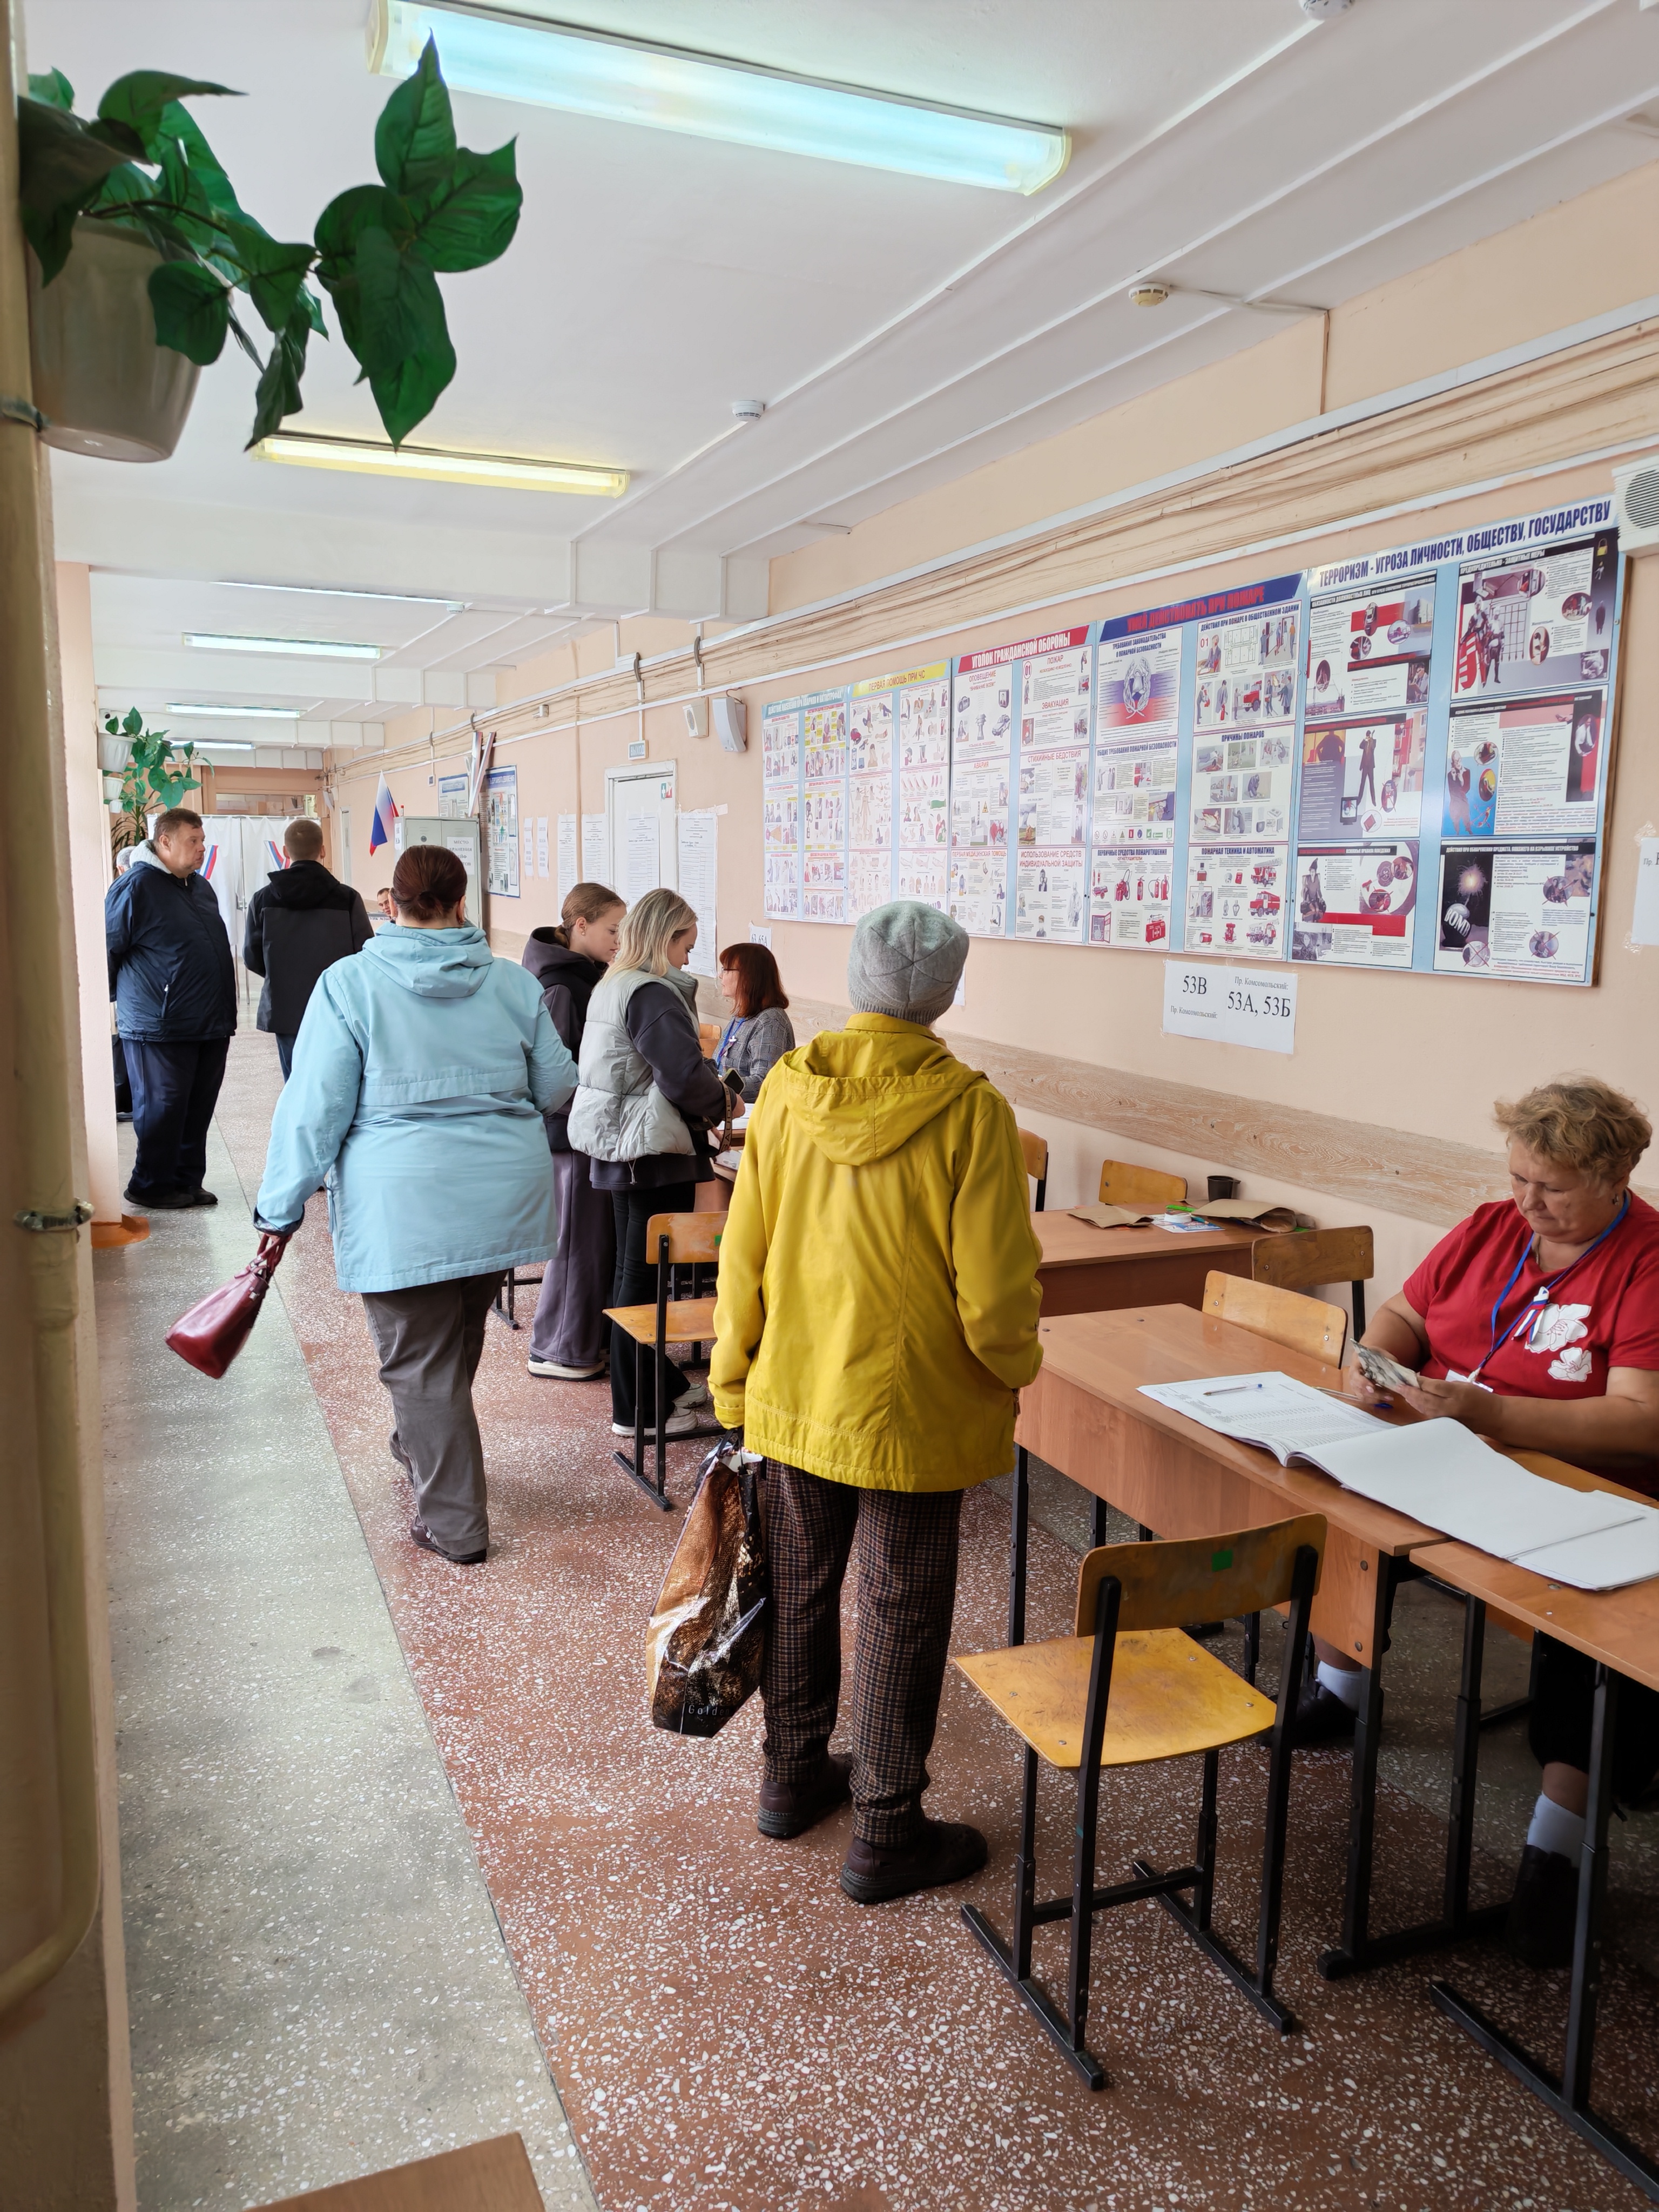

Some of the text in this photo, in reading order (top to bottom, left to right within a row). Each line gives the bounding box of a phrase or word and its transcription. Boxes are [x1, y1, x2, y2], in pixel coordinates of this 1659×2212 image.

[1320, 567, 1368, 587] ТЕРРОРИЗМ
[1375, 554, 1408, 574] УГРОЗА
[1410, 537, 1464, 565] ЛИЧНОСТИ,
[1467, 522, 1526, 553] ОБЩЕСТВУ,
[1528, 500, 1610, 536] ГОСУДАРСТВУ
[1208, 595, 1225, 613] ПРИ
[1201, 621, 1220, 632] ДЕЙСТВИЯ
[1220, 619, 1229, 628] ПРИ
[1229, 616, 1244, 625] ПОЖАРЕ
[1248, 608, 1281, 621] ОБЩЕСТВЕННОМ
[1112, 640, 1132, 650] ТРЕБОВАНИЯ
[1136, 642, 1162, 653] БЕЗОПАСНОСТИ
[1200, 637, 1209, 648] 01
[972, 632, 1070, 669] УГОЛОК ГРАЖДАНСКОЙ ОБОРОНЫ
[1047, 655, 1063, 665] ПОЖАР
[969, 670, 996, 682] ОПОВЕЩЕНИЕ
[1025, 665, 1031, 676] 01
[868, 670, 925, 691] ПЕРВАЯ ПОМОЩЬ ПРИ ЧС
[1042, 698, 1069, 709] ЭВАКУАЦИЯ
[1222, 730, 1265, 743] ПРИЧИНЫ ПОЖАРОВ
[1097, 740, 1177, 756] ОБЩИЕ ТРЕБОВАНИЯ ПОЖАРНОЙ БЕЗОПАСНОСТИ
[1028, 753, 1055, 763] СТИХИЙНЫЕ
[1056, 750, 1081, 760] БЕДСТВИЯ
[974, 761, 989, 769] АВАРИЯ
[1201, 847, 1224, 855] ПОЖАРНАЯ
[1246, 846, 1274, 854] АВТОМАТИКА
[1019, 859, 1083, 868] ИНДИВИДУАЛЬНОЙ ЗАЩИТЫ
[1444, 908, 1471, 937] BOMB
[1182, 975, 1207, 995] 53В
[1235, 976, 1289, 990] Пр. Комсомольский:
[1228, 991, 1291, 1017] 53А, 53Б
[1170, 1005, 1218, 1019] Пр. Комсомольский:
[688, 1704, 730, 1716] Golden
